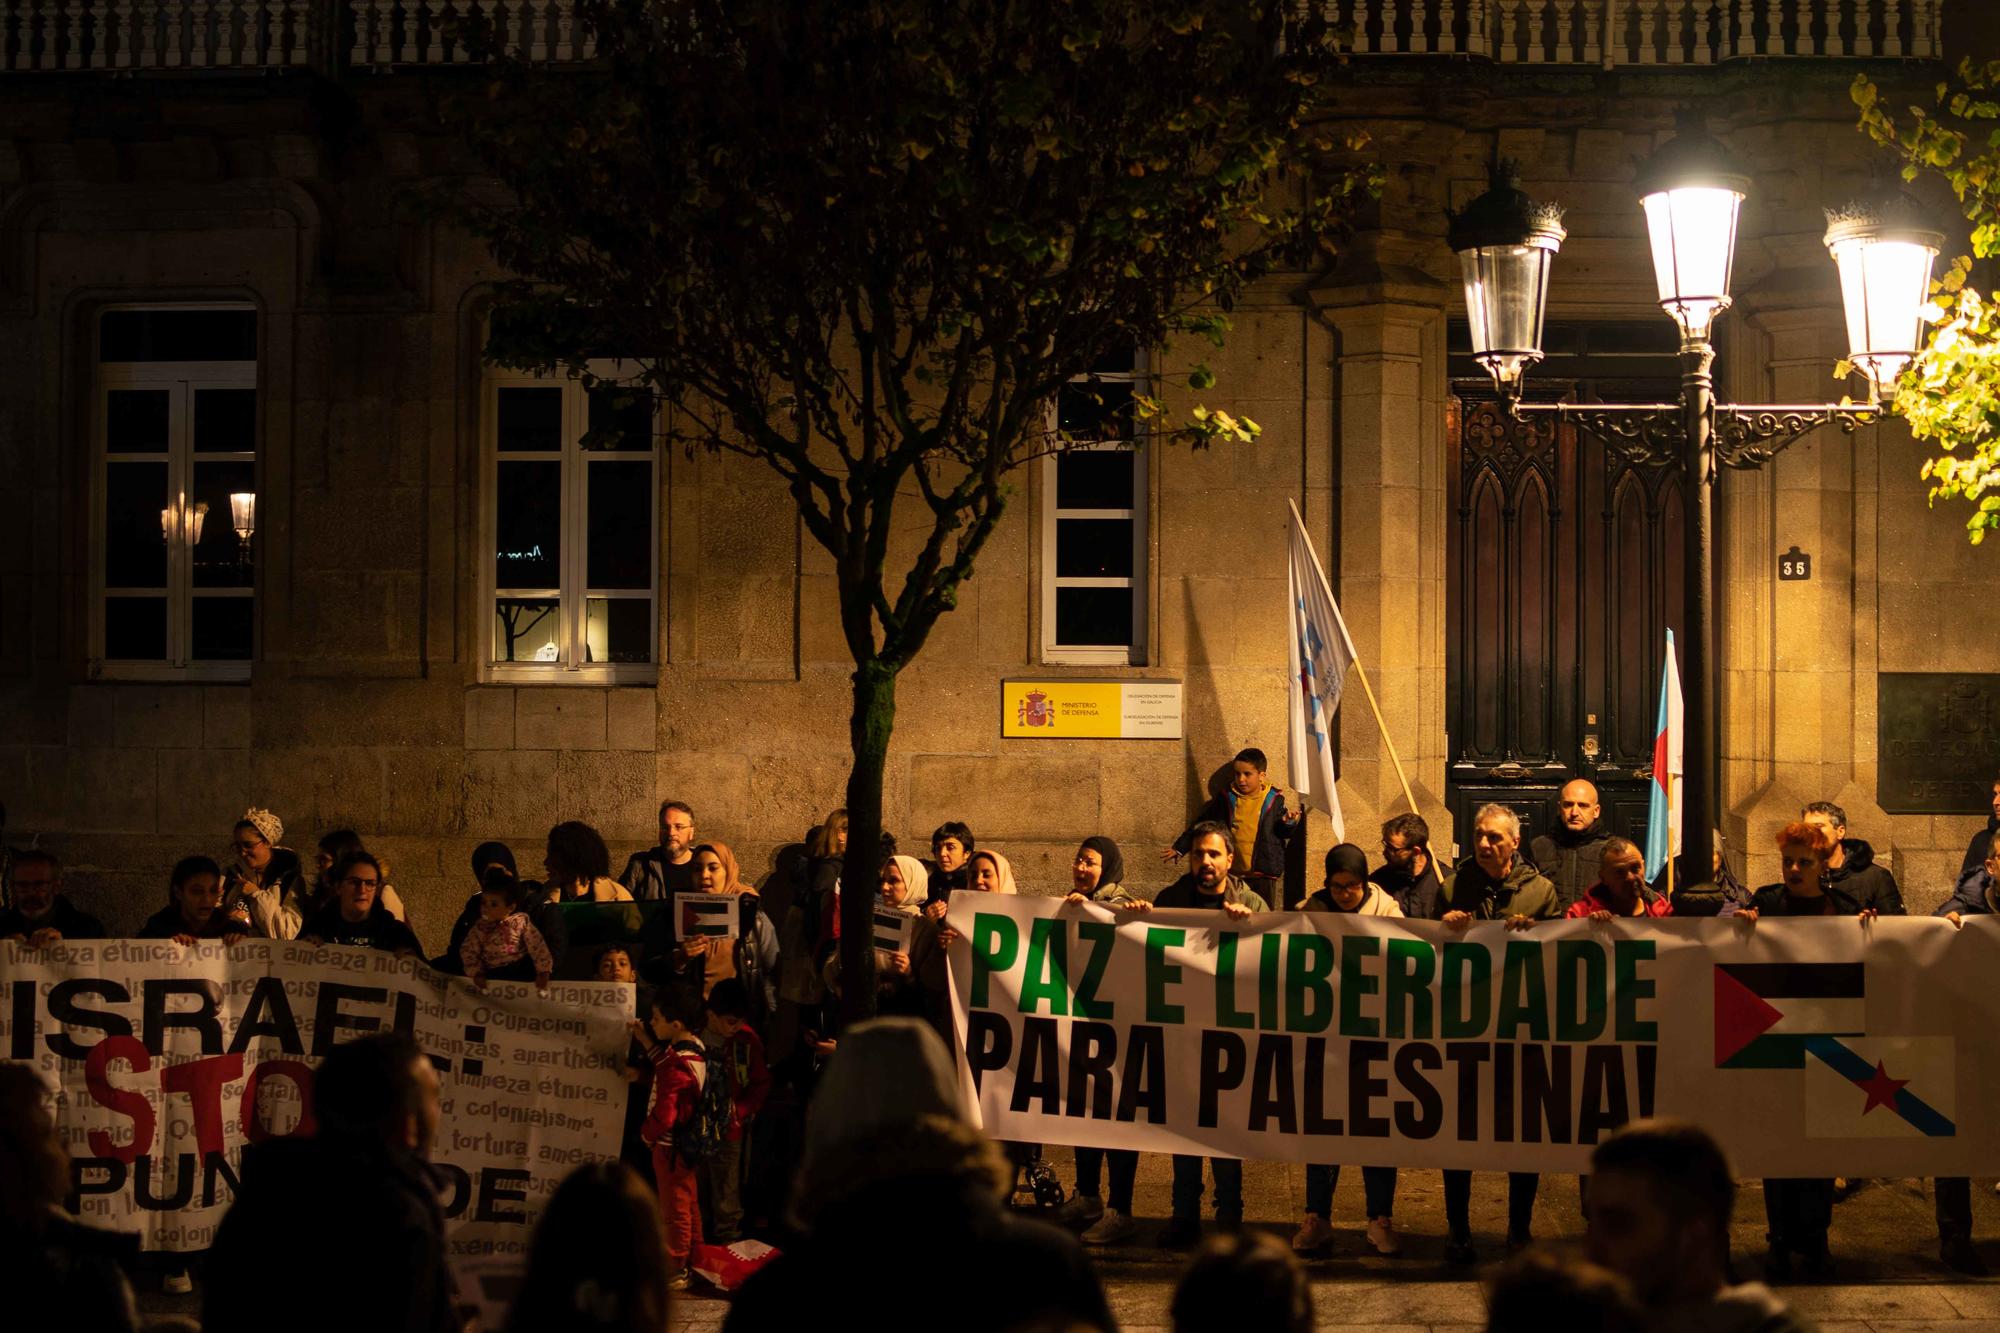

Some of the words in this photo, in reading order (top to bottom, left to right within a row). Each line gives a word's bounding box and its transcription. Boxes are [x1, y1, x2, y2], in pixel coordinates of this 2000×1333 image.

[1783, 561, 1805, 576] 35
[282, 946, 367, 972] ameaza
[970, 912, 1116, 1021] PAZ
[1145, 928, 1185, 1024] E
[1215, 930, 1659, 1043] LIBERDADE
[967, 1011, 1167, 1124] PARA
[1198, 1029, 1657, 1145] PALESTINA!
